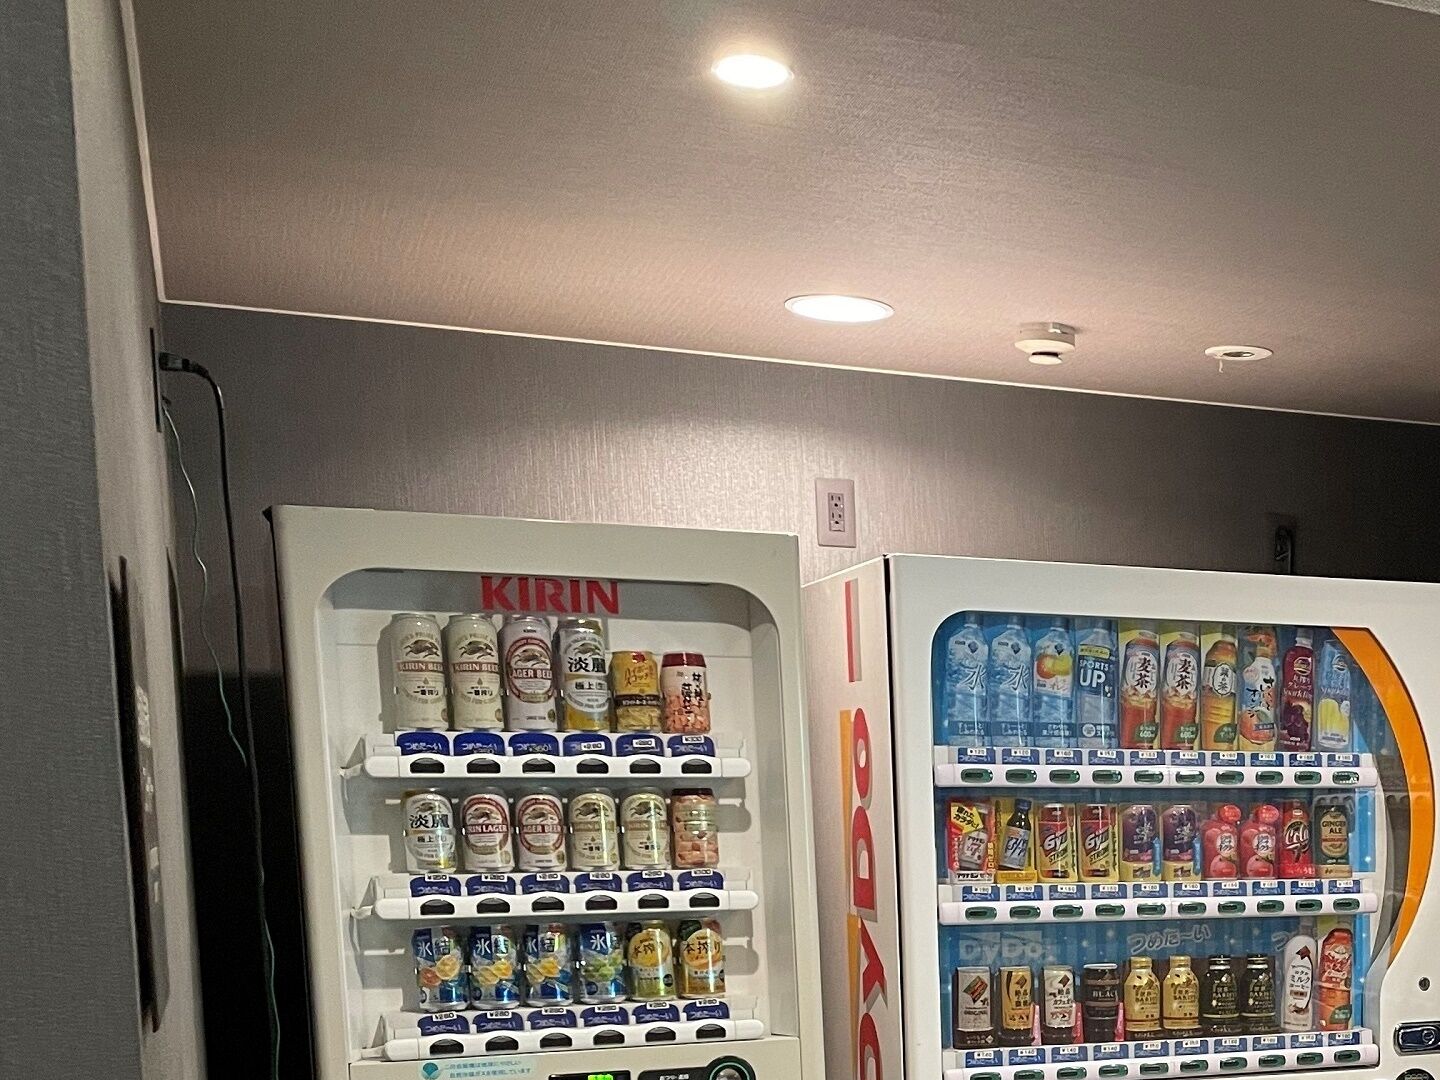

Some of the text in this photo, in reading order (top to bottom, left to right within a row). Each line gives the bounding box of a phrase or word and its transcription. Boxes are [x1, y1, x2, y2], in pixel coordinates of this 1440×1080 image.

[480, 576, 620, 615] KIRIN
[511, 668, 534, 678] AGER
[1079, 659, 1109, 671] SPORTS
[1135, 657, 1152, 689] 麦茶
[1176, 659, 1192, 690] 麦茶
[962, 665, 986, 690] 水
[1006, 664, 1029, 691] 水
[1079, 671, 1106, 688] UP
[483, 824, 507, 832] LAGER
[523, 825, 542, 833] AGER
